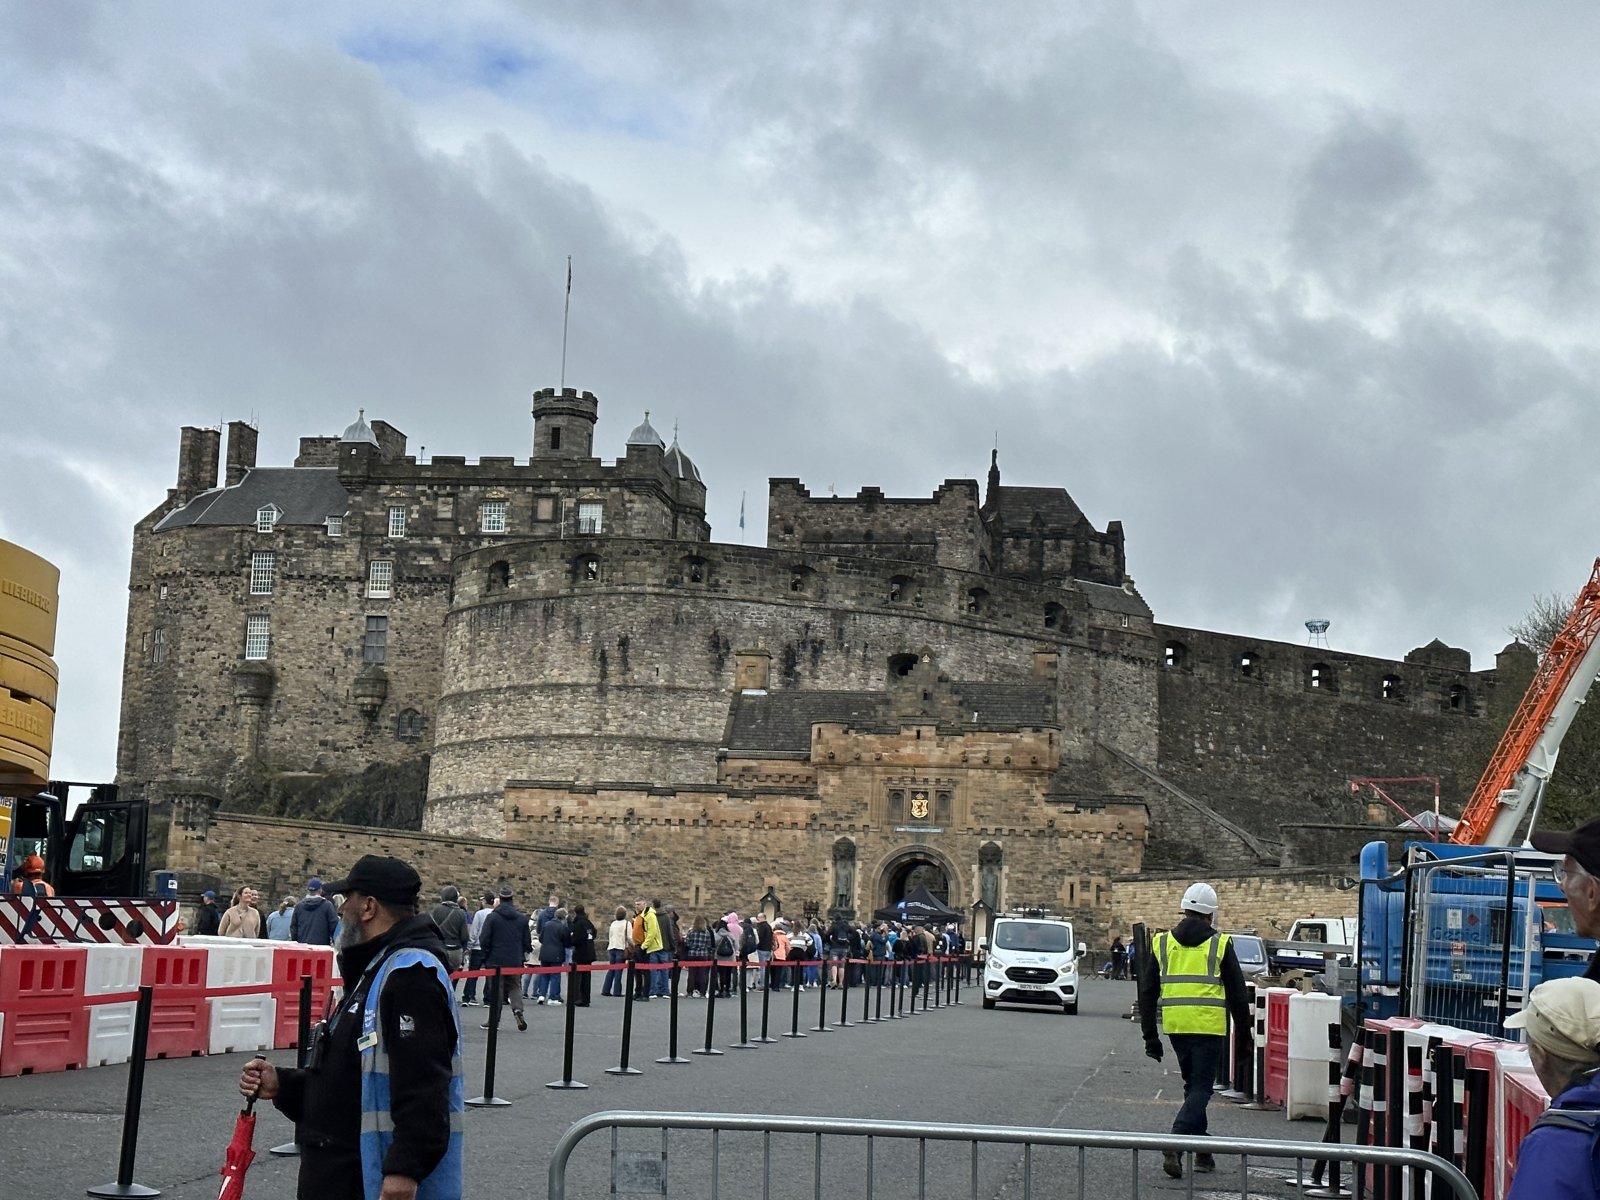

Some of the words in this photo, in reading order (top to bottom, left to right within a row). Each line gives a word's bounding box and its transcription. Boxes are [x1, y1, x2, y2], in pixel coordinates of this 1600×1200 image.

[2, 578, 49, 613] LIEBHERR
[0, 707, 43, 737] EBHERR
[1432, 926, 1480, 942] Genie
